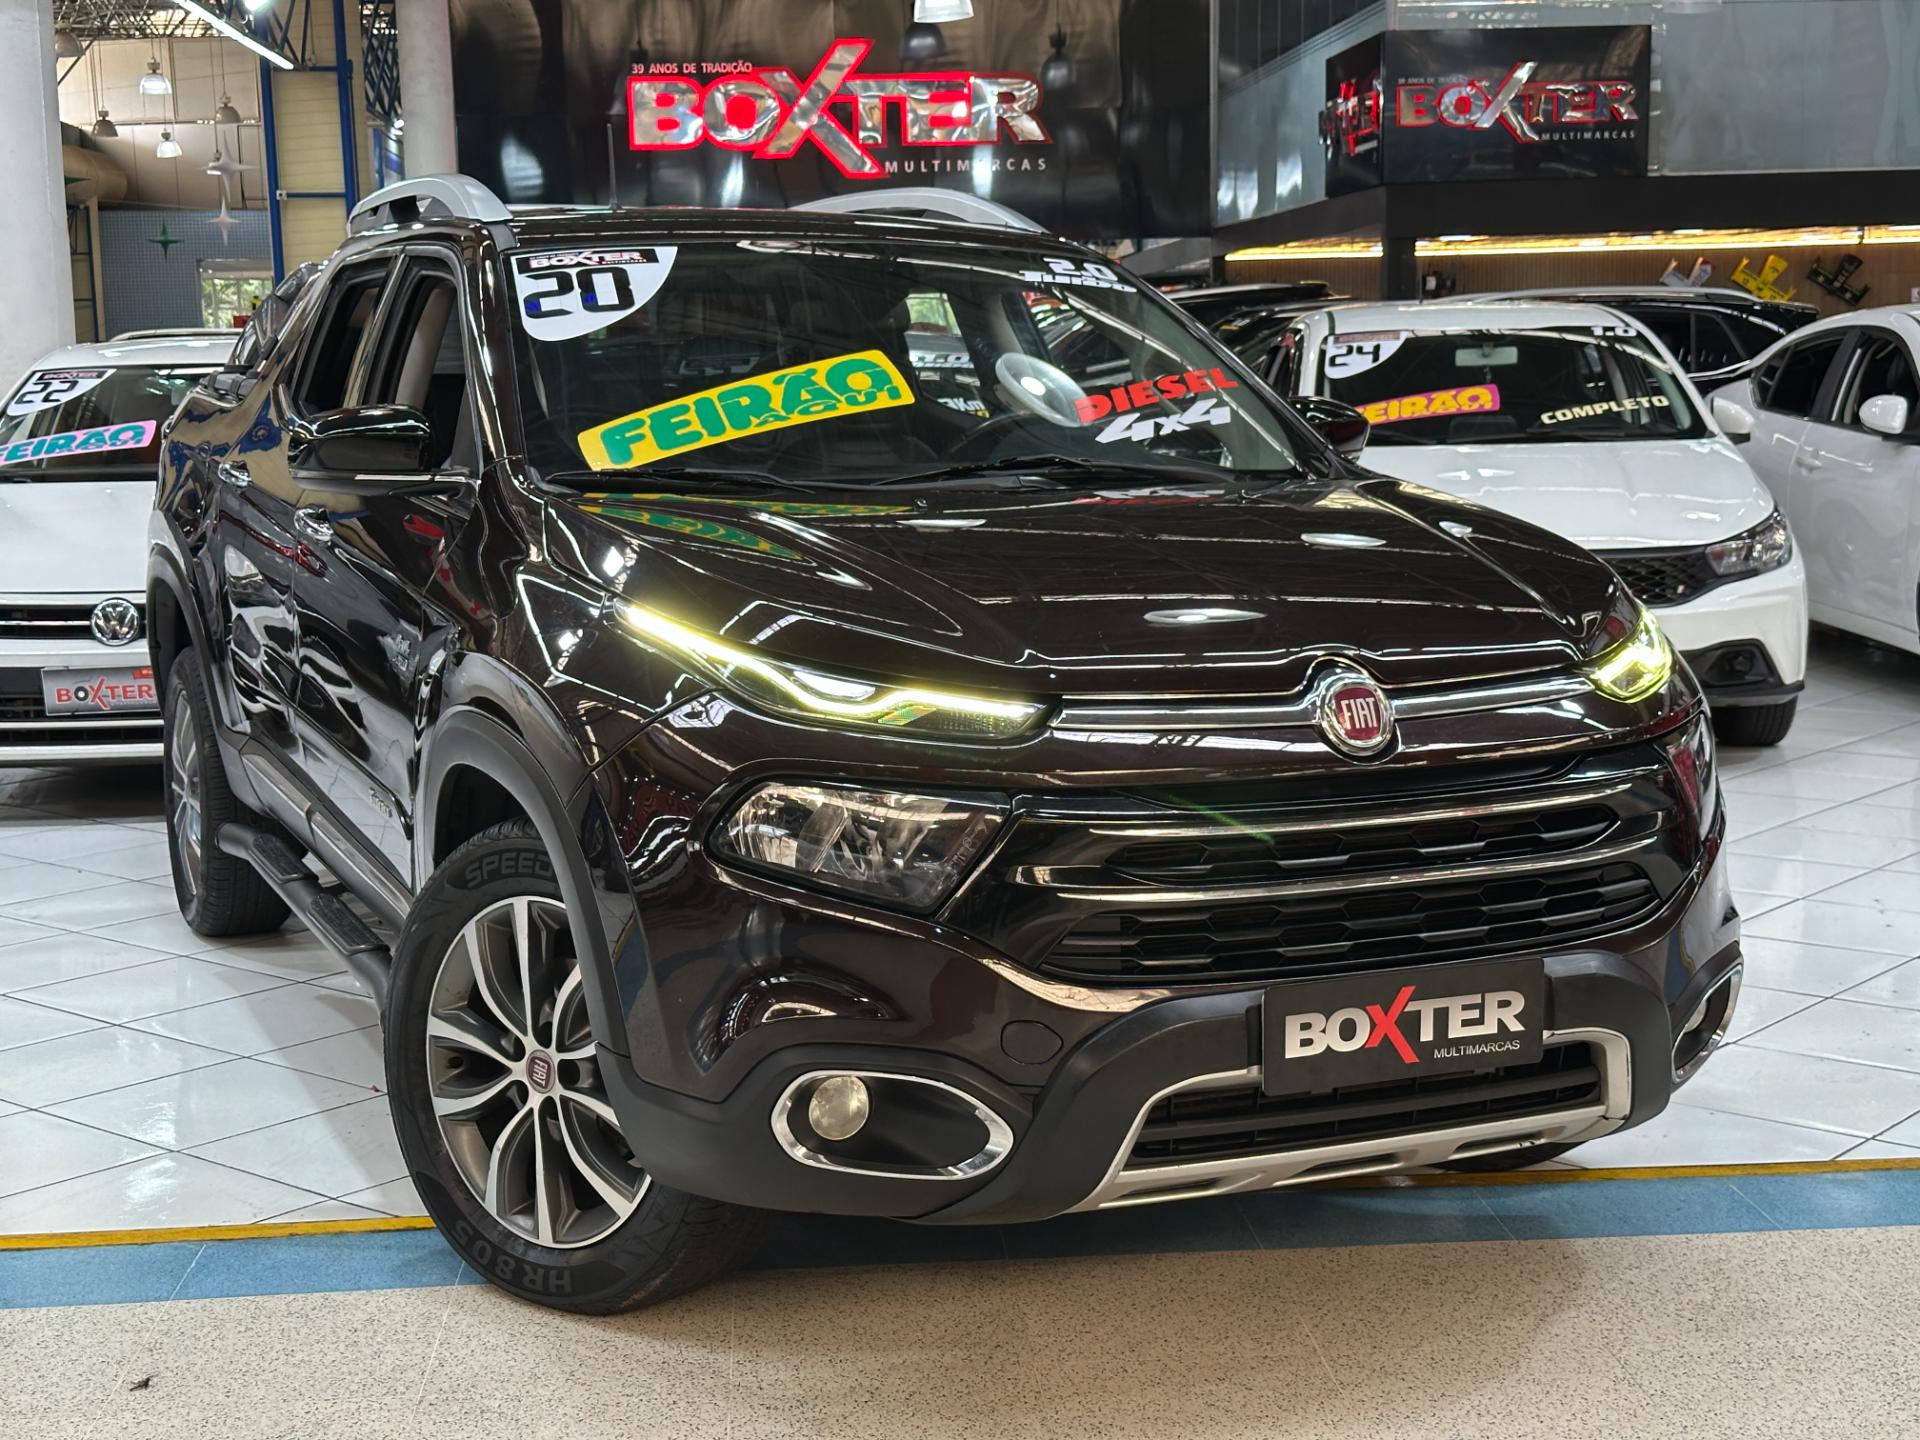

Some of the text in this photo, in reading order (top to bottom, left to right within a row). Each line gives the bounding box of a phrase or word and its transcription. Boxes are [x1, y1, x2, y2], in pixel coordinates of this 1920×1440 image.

[632, 60, 753, 74] 39 ANOS DE TRADIÇÃO
[627, 38, 1053, 179] BOXTER
[1396, 60, 1640, 143] BOXTER
[1541, 130, 1636, 141] MULTIMARCAS
[885, 158, 1047, 173] MULTIMRCAS
[528, 251, 642, 269] BOXTER
[1043, 257, 1118, 281] 2.0
[523, 266, 636, 319] 20
[1328, 343, 1381, 368] 24
[15, 380, 79, 404] 22
[1075, 367, 1239, 424] DIESEL
[600, 358, 894, 465] FEIRÃO
[1095, 398, 1232, 444] 4x4
[1541, 395, 1670, 424] COMPLETO
[56, 677, 154, 711] BOXTER
[1341, 697, 1378, 730] FIAT
[1285, 985, 1526, 1064] BOXTER
[1434, 1039, 1520, 1059] MULTIMARCAS
[532, 1059, 549, 1087] FIAT
